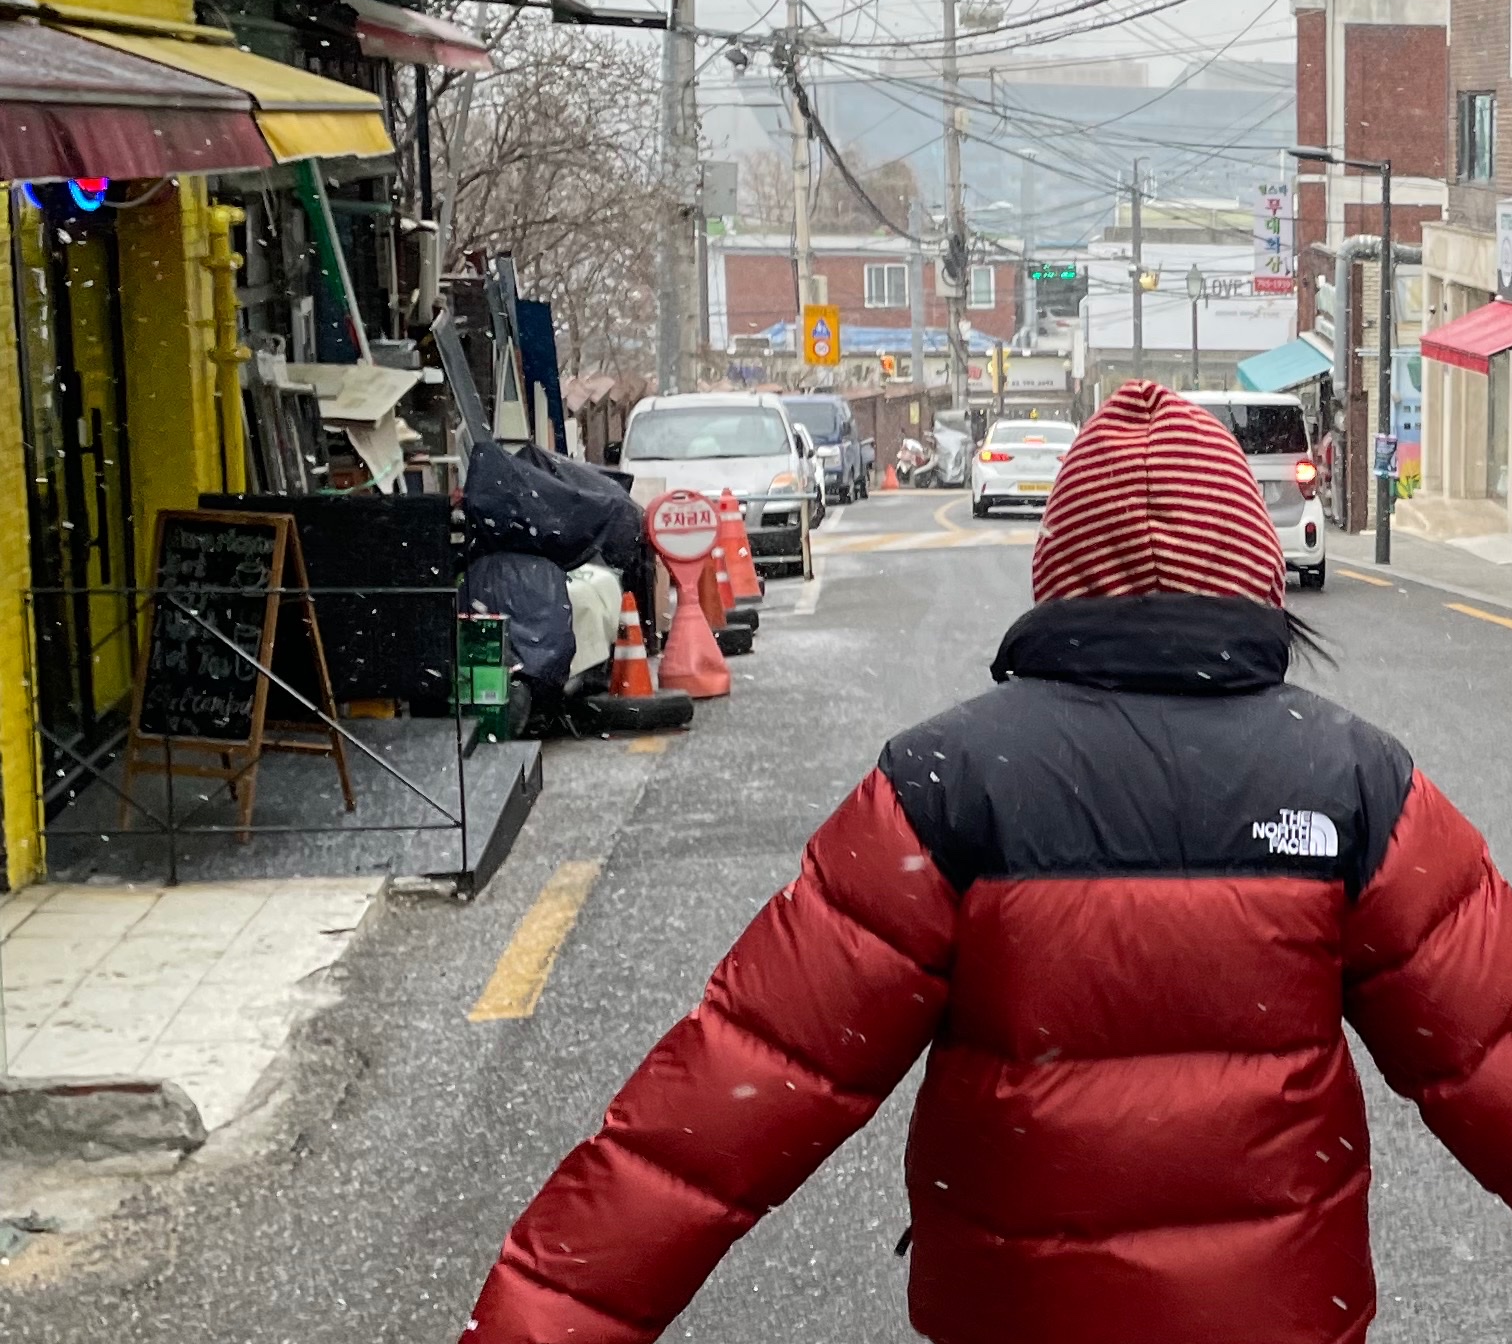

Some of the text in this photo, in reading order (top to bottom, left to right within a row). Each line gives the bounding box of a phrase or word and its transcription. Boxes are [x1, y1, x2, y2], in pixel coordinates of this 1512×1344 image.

[1279, 809, 1312, 824] THE
[1252, 822, 1311, 840] NORTH
[1269, 837, 1310, 856] FACE
